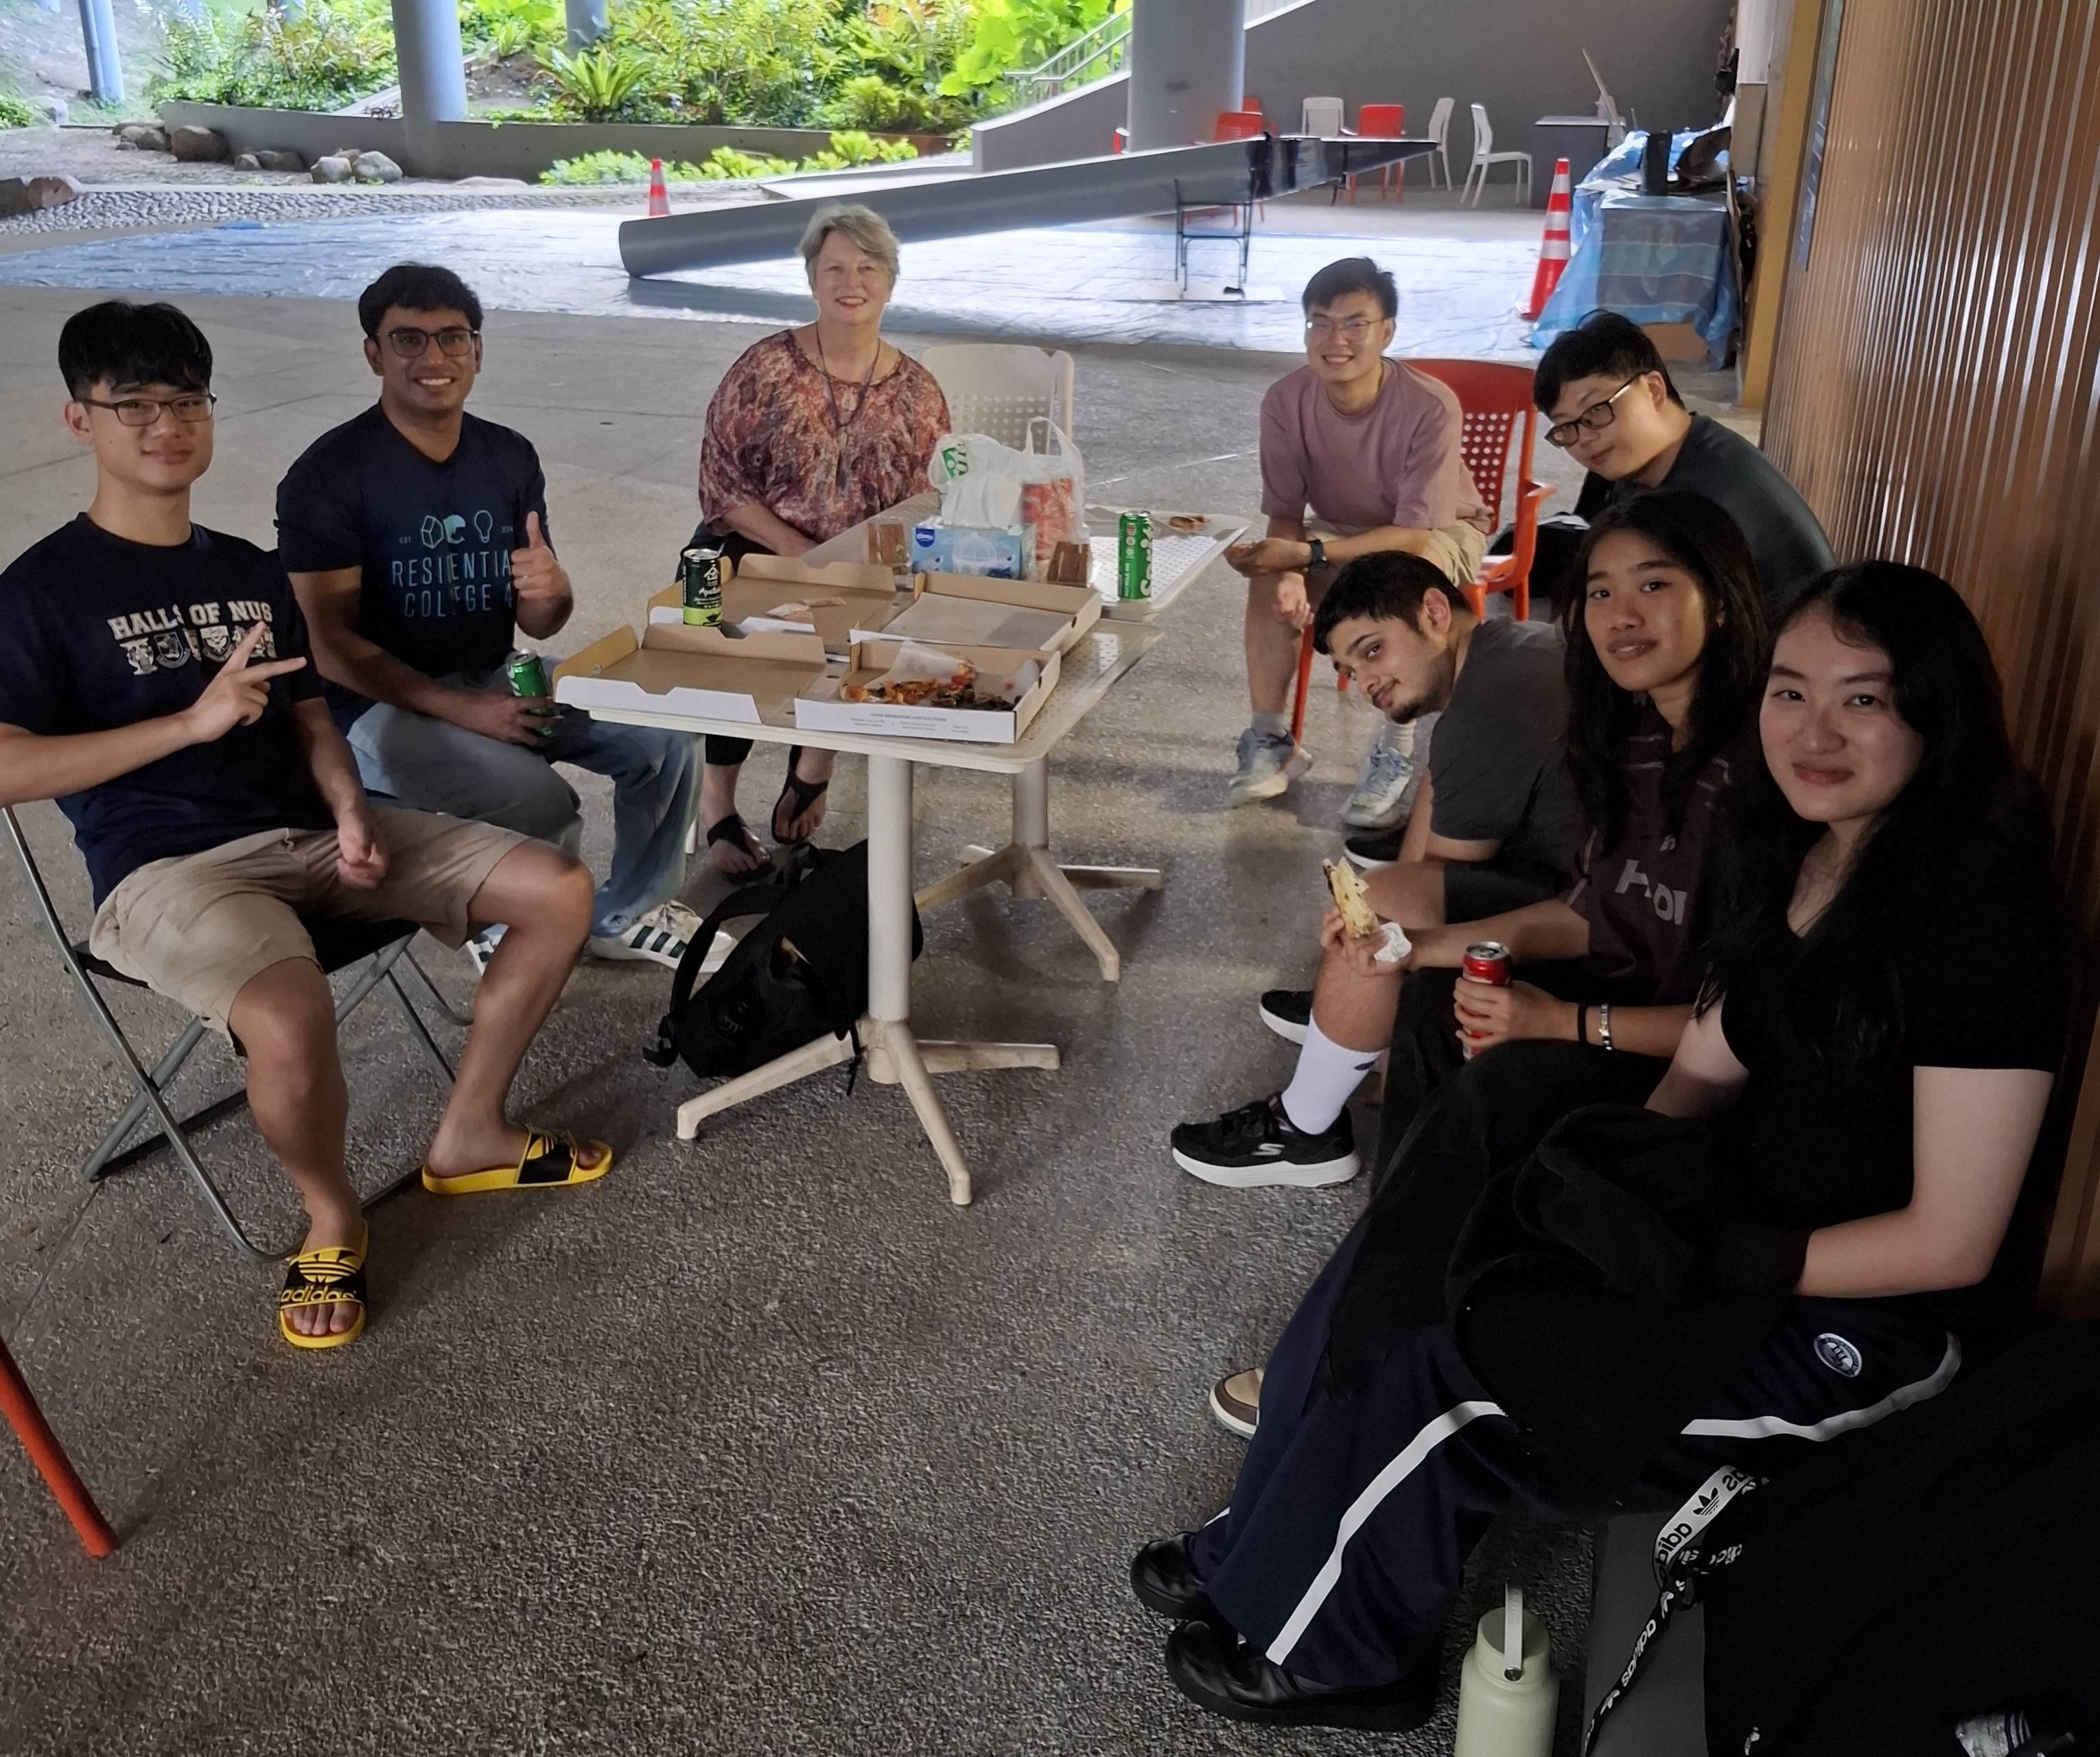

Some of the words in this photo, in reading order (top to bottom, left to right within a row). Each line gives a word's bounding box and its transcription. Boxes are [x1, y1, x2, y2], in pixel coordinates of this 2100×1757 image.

[188, 602, 220, 625] OF
[226, 601, 272, 622] NUS
[1621, 1618, 1656, 1687] adidas
